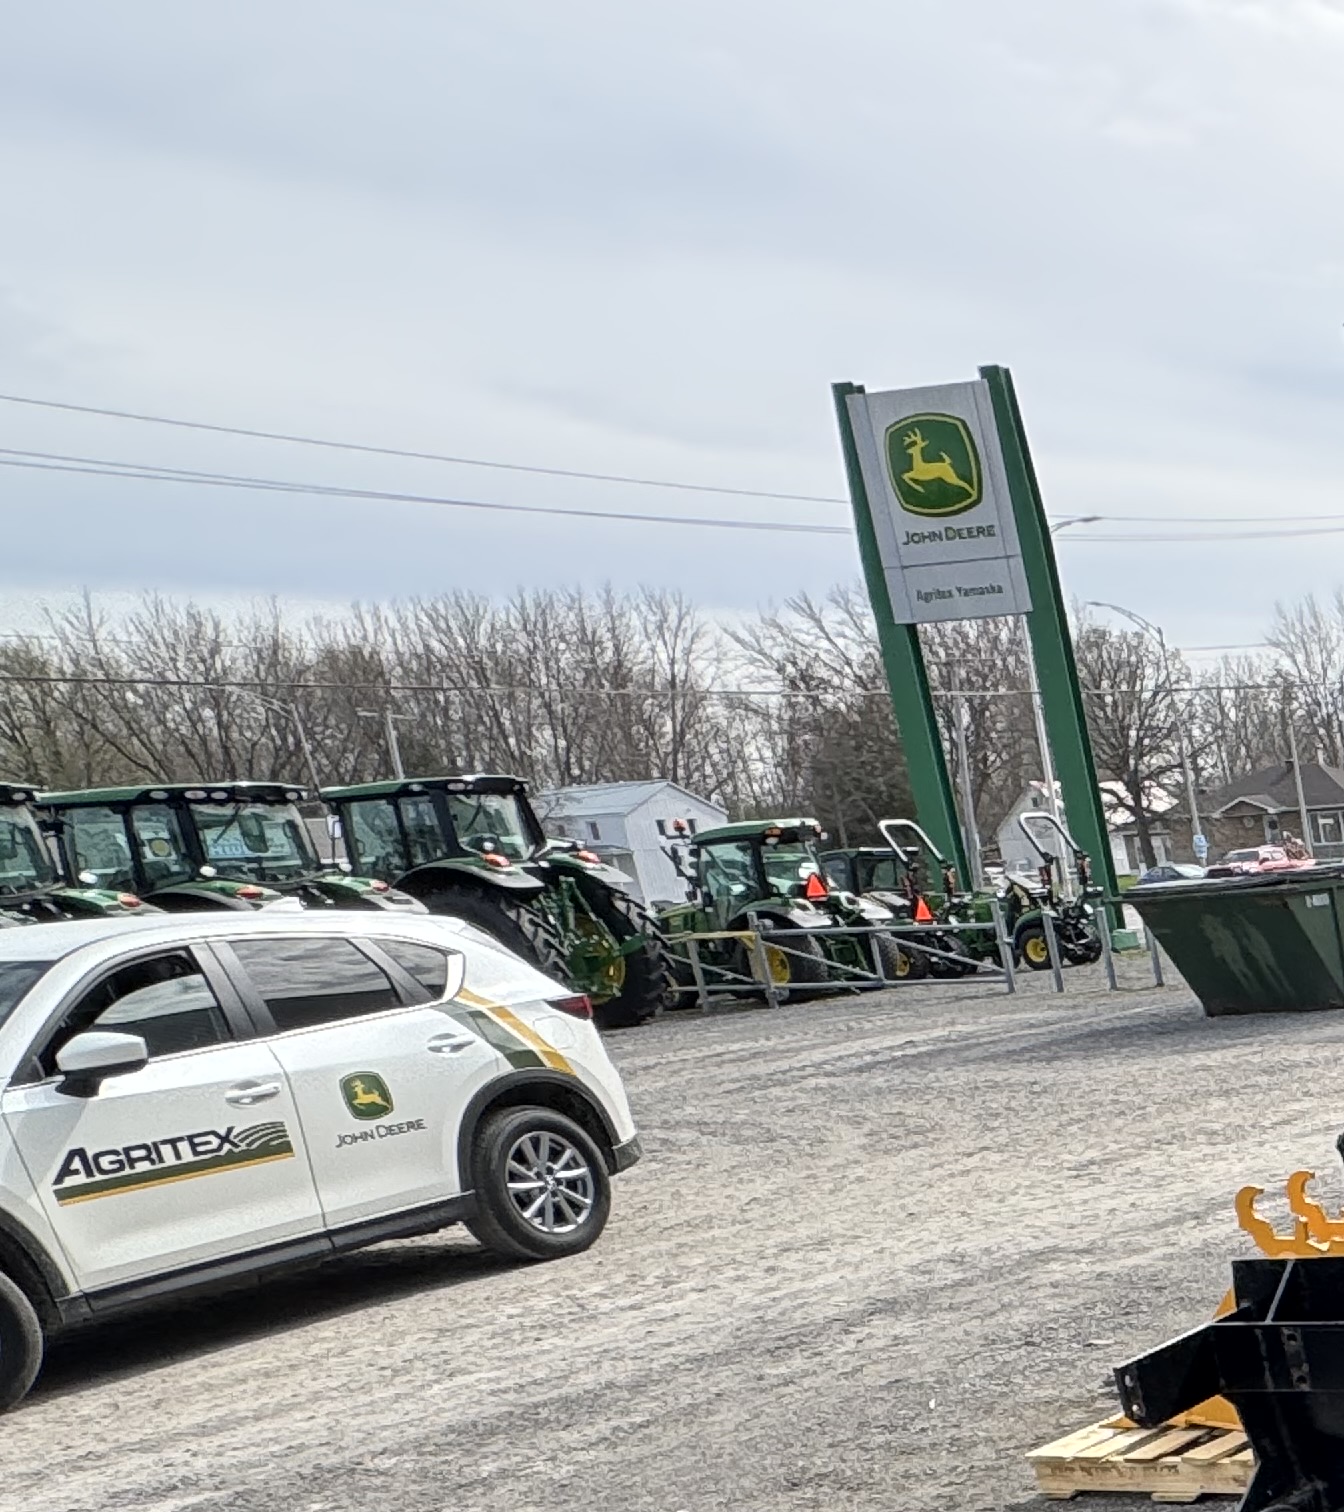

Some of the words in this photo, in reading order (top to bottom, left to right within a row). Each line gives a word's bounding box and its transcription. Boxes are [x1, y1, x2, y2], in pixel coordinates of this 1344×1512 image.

[902, 530, 943, 545] JOHN
[944, 525, 996, 541] DEERE
[335, 1129, 375, 1148] JOHN
[375, 1118, 426, 1138] DEERE
[52, 1126, 242, 1186] AGRITEX
